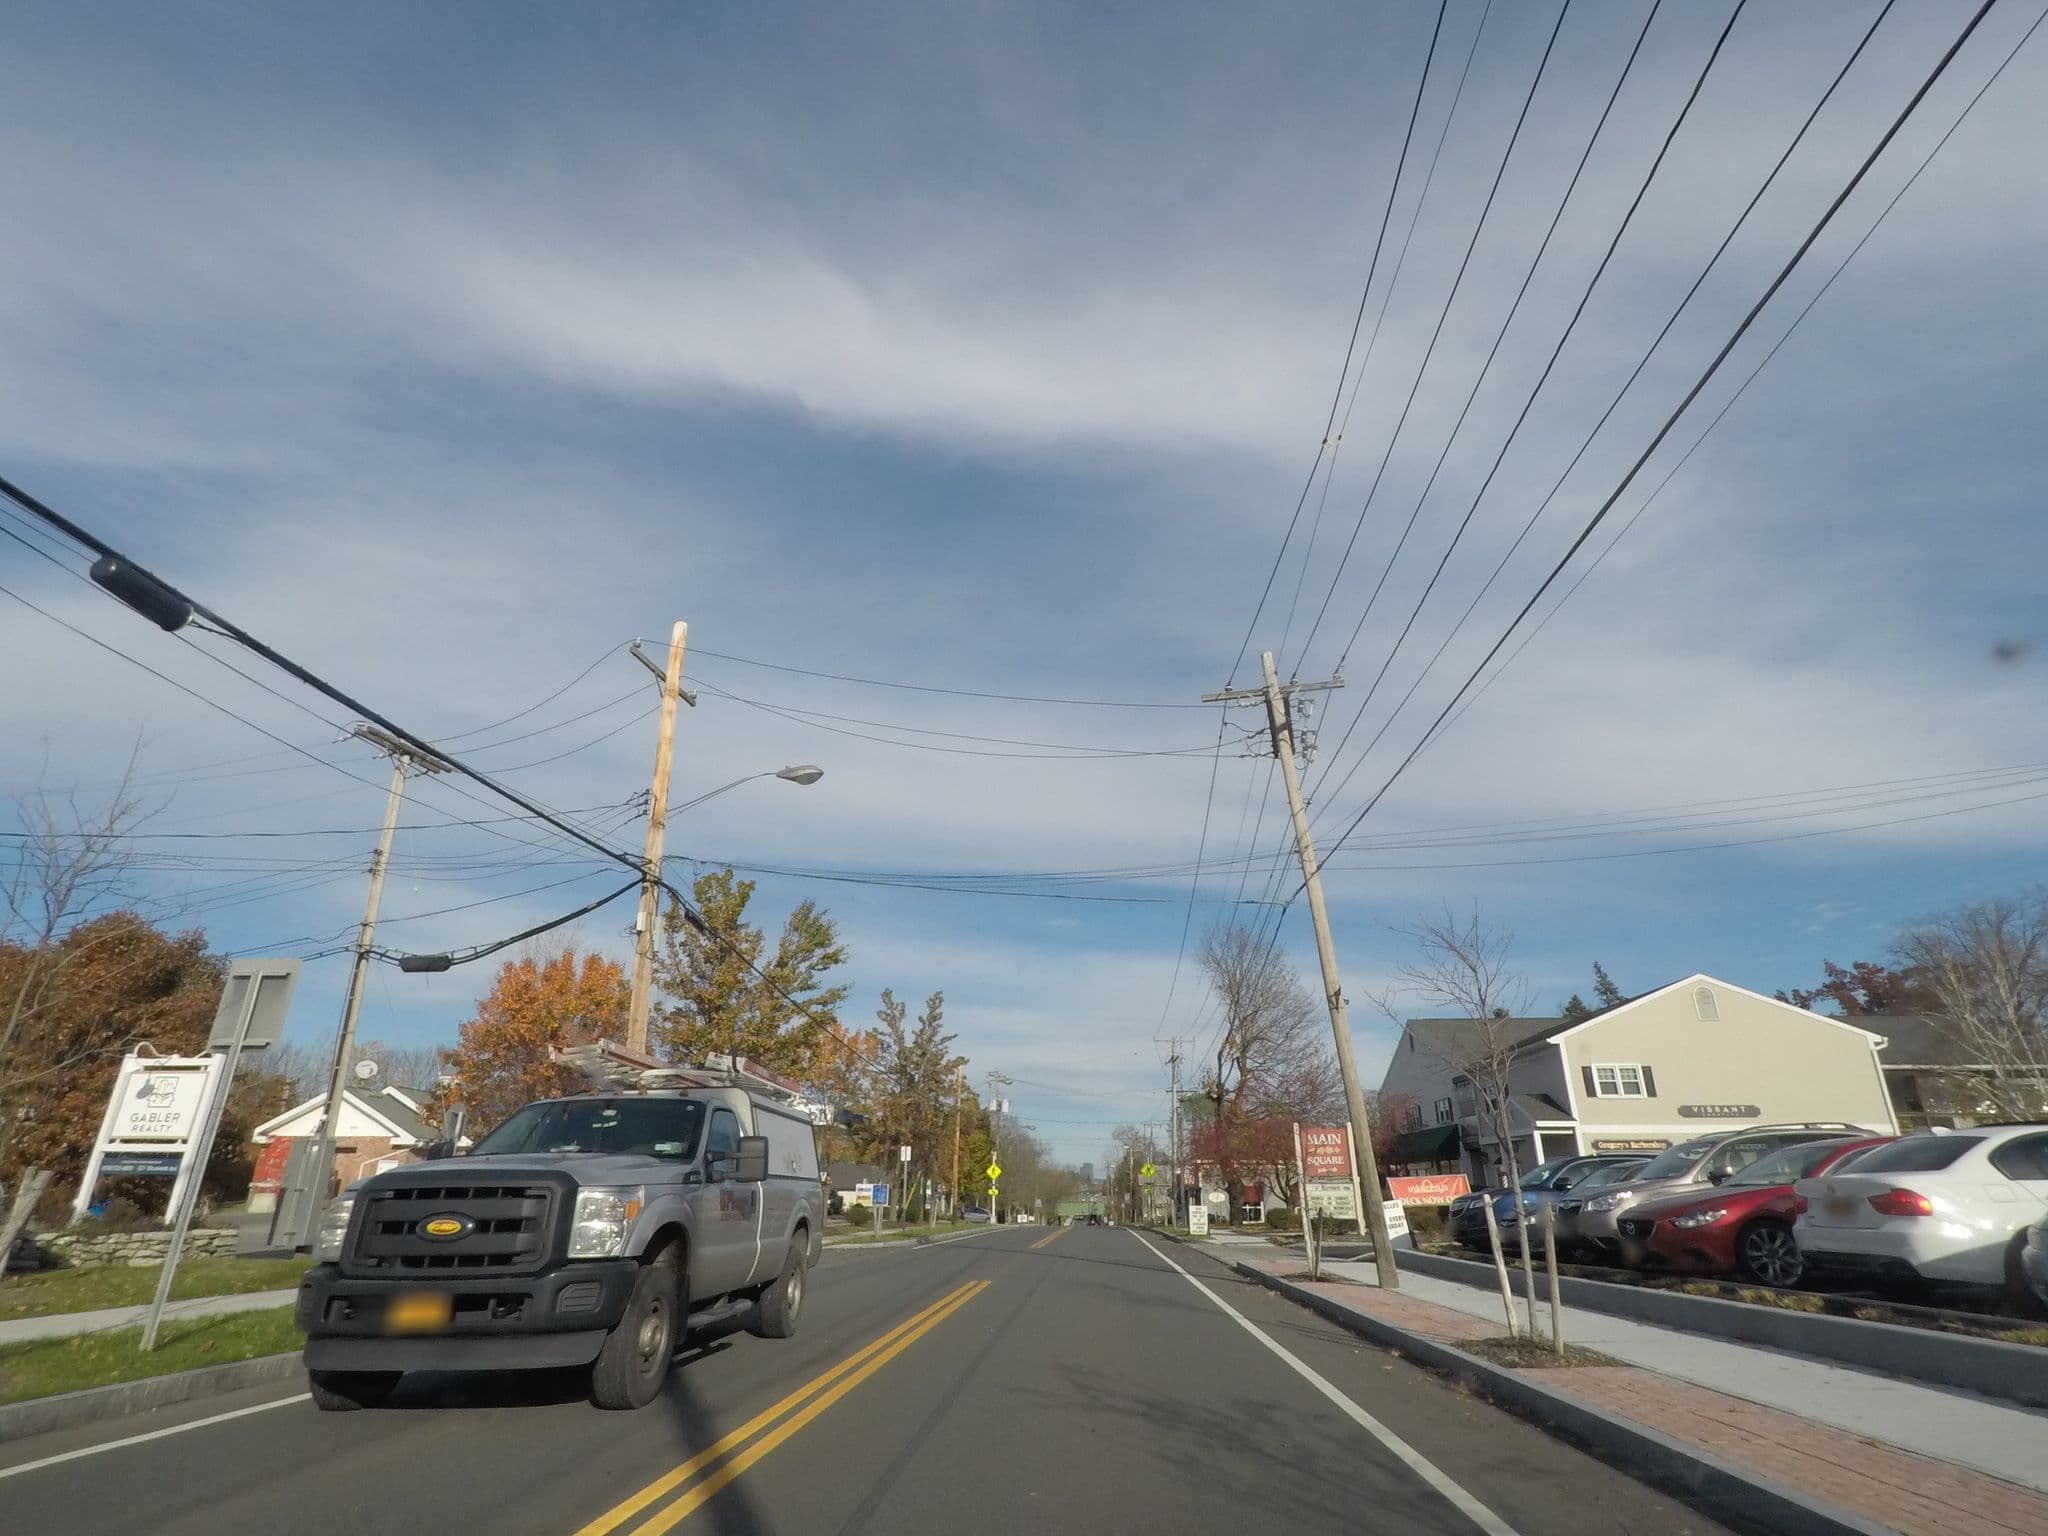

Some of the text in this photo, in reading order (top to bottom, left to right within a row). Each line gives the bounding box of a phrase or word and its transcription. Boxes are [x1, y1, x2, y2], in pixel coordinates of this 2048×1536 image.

[130, 1112, 181, 1123] GABLER
[131, 1124, 173, 1132] REALTY
[1307, 1133, 1342, 1145] MAIN
[1307, 1155, 1345, 1166] SQUARE
[1423, 1195, 1445, 1205] NOW
